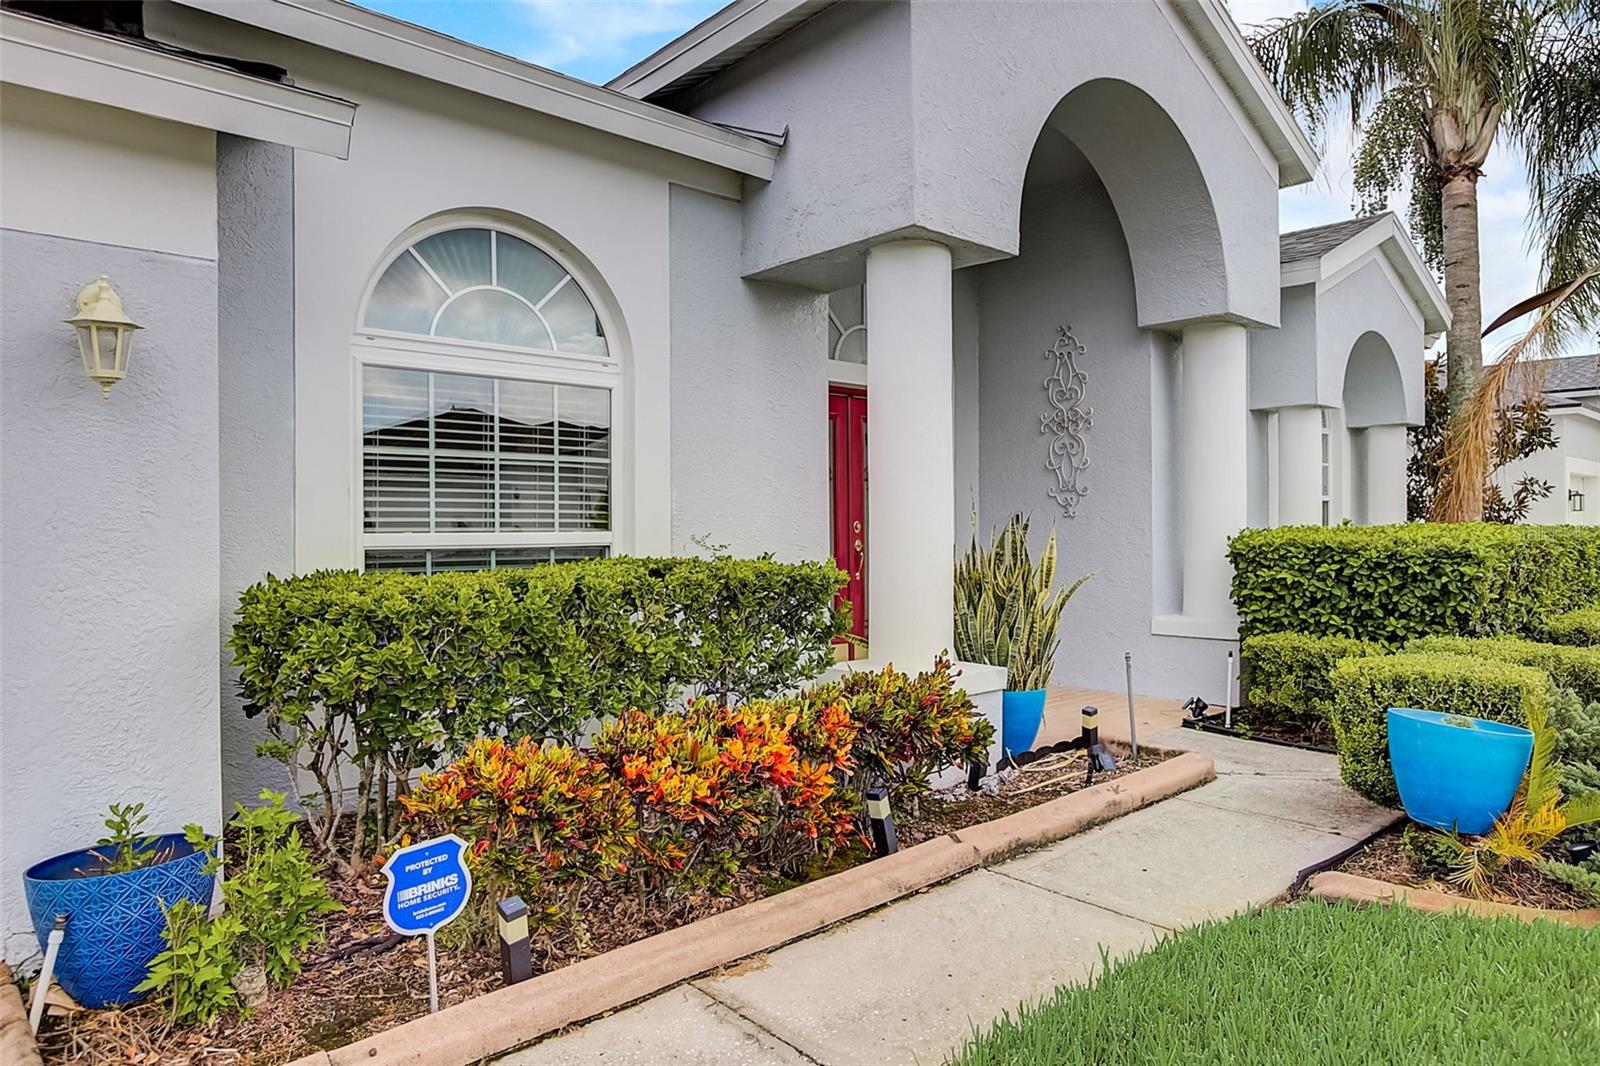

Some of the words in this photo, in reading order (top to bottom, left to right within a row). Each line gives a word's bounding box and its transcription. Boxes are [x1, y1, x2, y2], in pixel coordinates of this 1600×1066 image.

[405, 854, 448, 873] PROTECTED
[422, 866, 433, 876] BY
[409, 873, 459, 898] BRINKS
[397, 897, 422, 910] HOME
